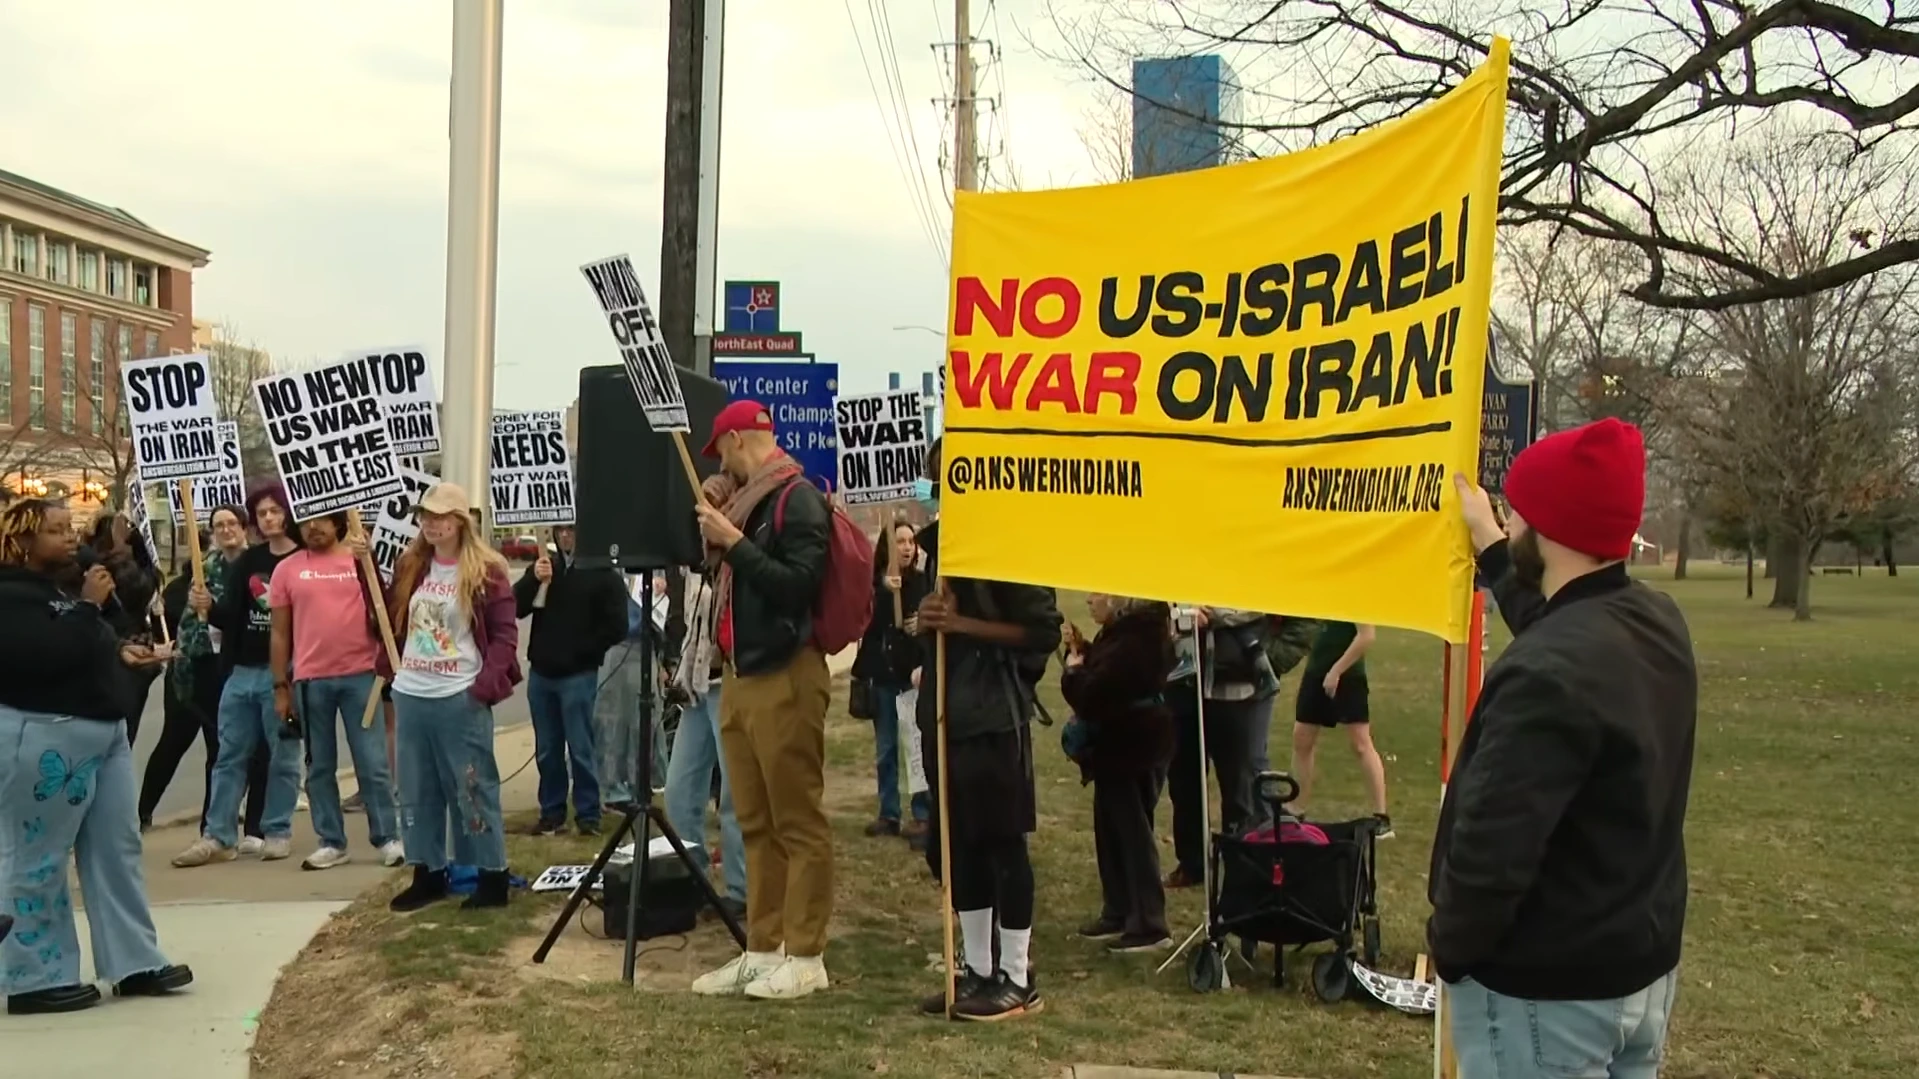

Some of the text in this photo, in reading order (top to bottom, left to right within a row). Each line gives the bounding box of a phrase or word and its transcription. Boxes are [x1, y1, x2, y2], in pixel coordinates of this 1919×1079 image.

[954, 193, 1470, 339] NO US-ISRAELI
[610, 307, 657, 346] OFF
[766, 338, 795, 351] Quad
[366, 352, 425, 396] TOP
[950, 306, 1461, 424] WAR ON IRAN!
[128, 361, 206, 413] STOP
[258, 359, 372, 420] NO NEW
[755, 377, 809, 395] Center
[269, 397, 382, 446] US WAR
[389, 401, 432, 414] WAR
[492, 411, 561, 424] ONEY FOR
[779, 403, 834, 427] Champs
[837, 391, 921, 424] STOP THE
[135, 416, 214, 435] THE WAR
[493, 420, 562, 434] EOPLE'S
[786, 431, 801, 449] St
[839, 419, 924, 449] WAR
[139, 432, 167, 464] ON
[169, 429, 217, 462] IRAN
[278, 428, 389, 475] IN THE
[491, 431, 566, 468] NEEDS
[169, 473, 240, 488] NT WAR
[285, 462, 354, 502] MIDDLE
[352, 452, 395, 485] EAST
[491, 470, 569, 484] NOT WAR
[842, 450, 872, 490] ON
[947, 456, 1143, 498] @ANSWERINDIANA
[201, 482, 243, 508] IRAN
[492, 481, 572, 510] W/ IRAN
[1282, 463, 1445, 512] ANSWERINDIANA.ORG
